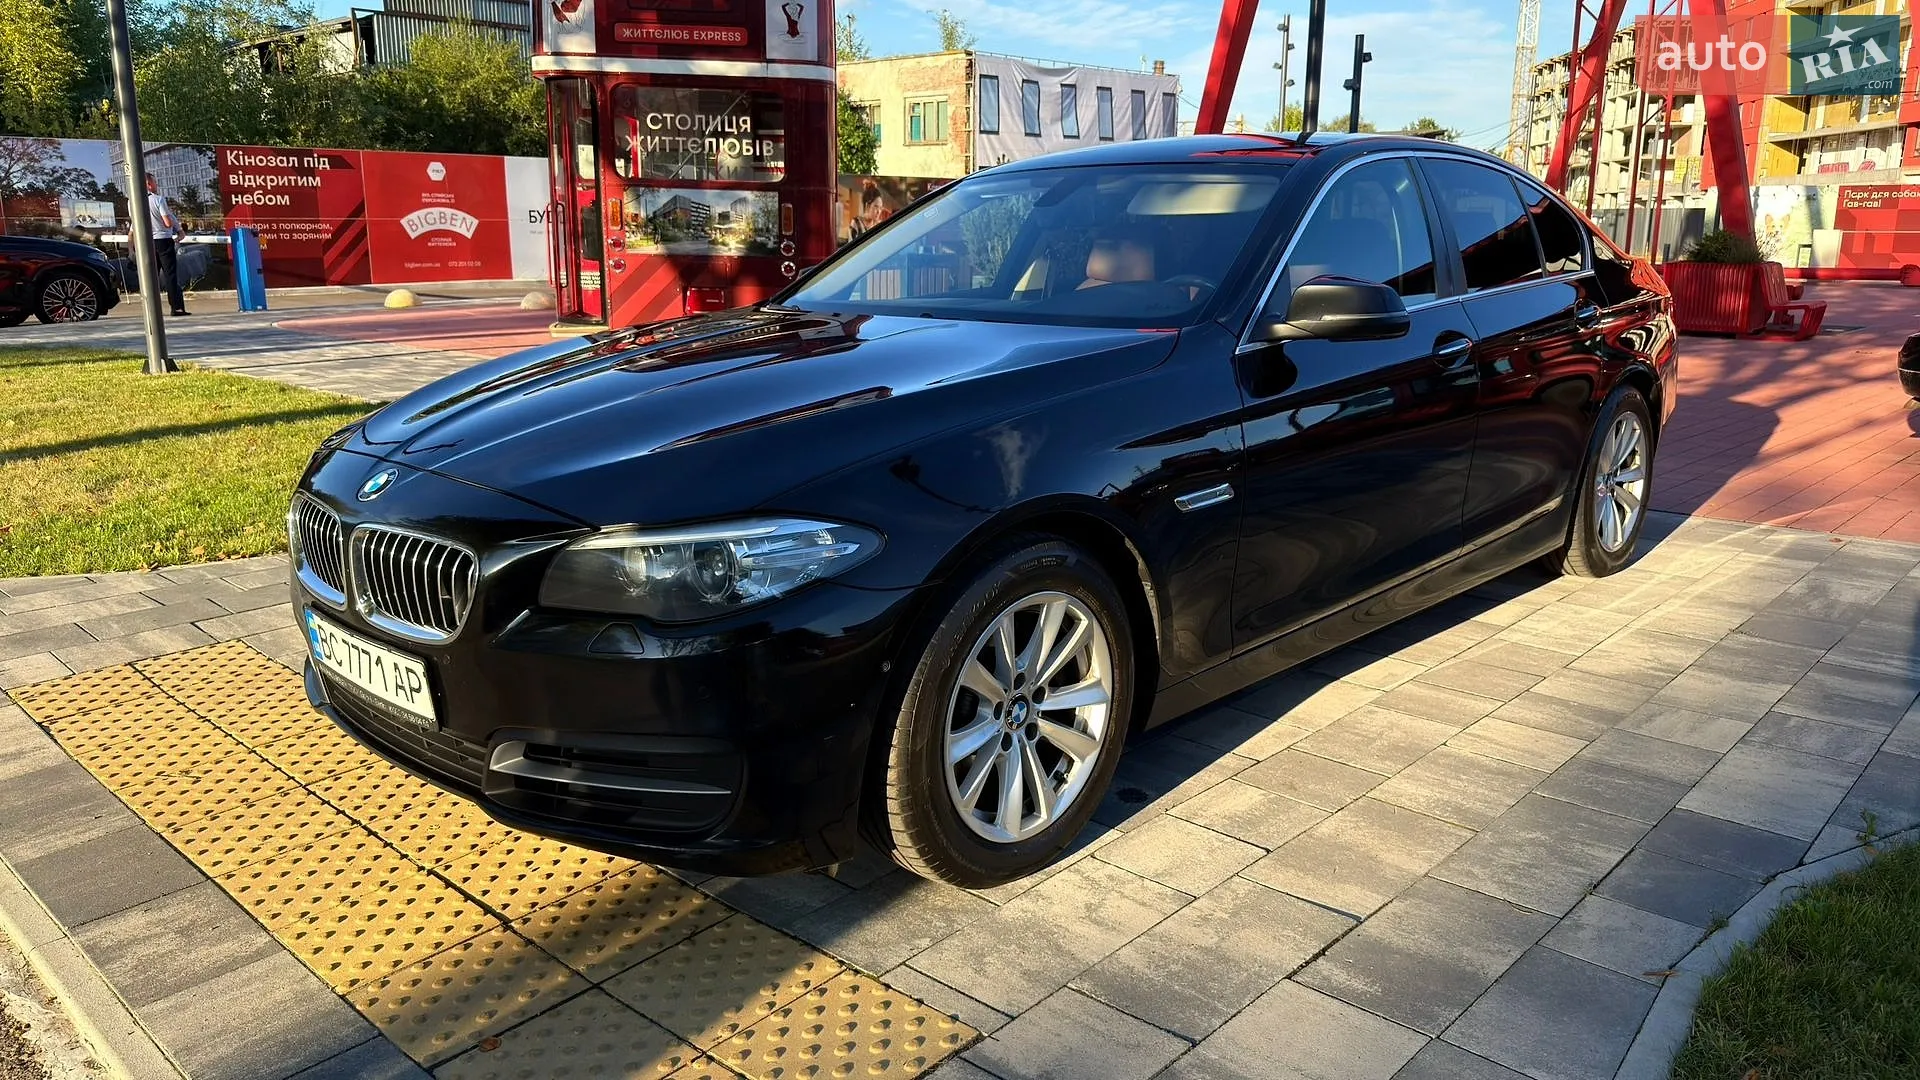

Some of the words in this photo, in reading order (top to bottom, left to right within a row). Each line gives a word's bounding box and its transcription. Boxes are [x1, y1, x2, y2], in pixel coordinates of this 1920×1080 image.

[623, 28, 689, 40] ЖИТТЄЛЮБ
[693, 30, 741, 41] EXPRESS
[646, 112, 751, 135] СТОЛИЦЯ
[625, 135, 774, 157] ЖИТТЄЛЮБІВ
[226, 150, 298, 167] Кінозал
[303, 153, 330, 170] під
[229, 170, 321, 189] відкритим
[231, 190, 290, 206] небом
[1843, 199, 1881, 208] Гав-гав!
[1844, 190, 1869, 200] Парк
[1871, 191, 1889, 199] для
[279, 222, 333, 231] попкорном,
[406, 211, 474, 233] BIGBEN
[292, 233, 332, 241] зоряним
[317, 624, 343, 667] BC
[341, 639, 388, 693] 7771
[393, 661, 422, 704] AP
